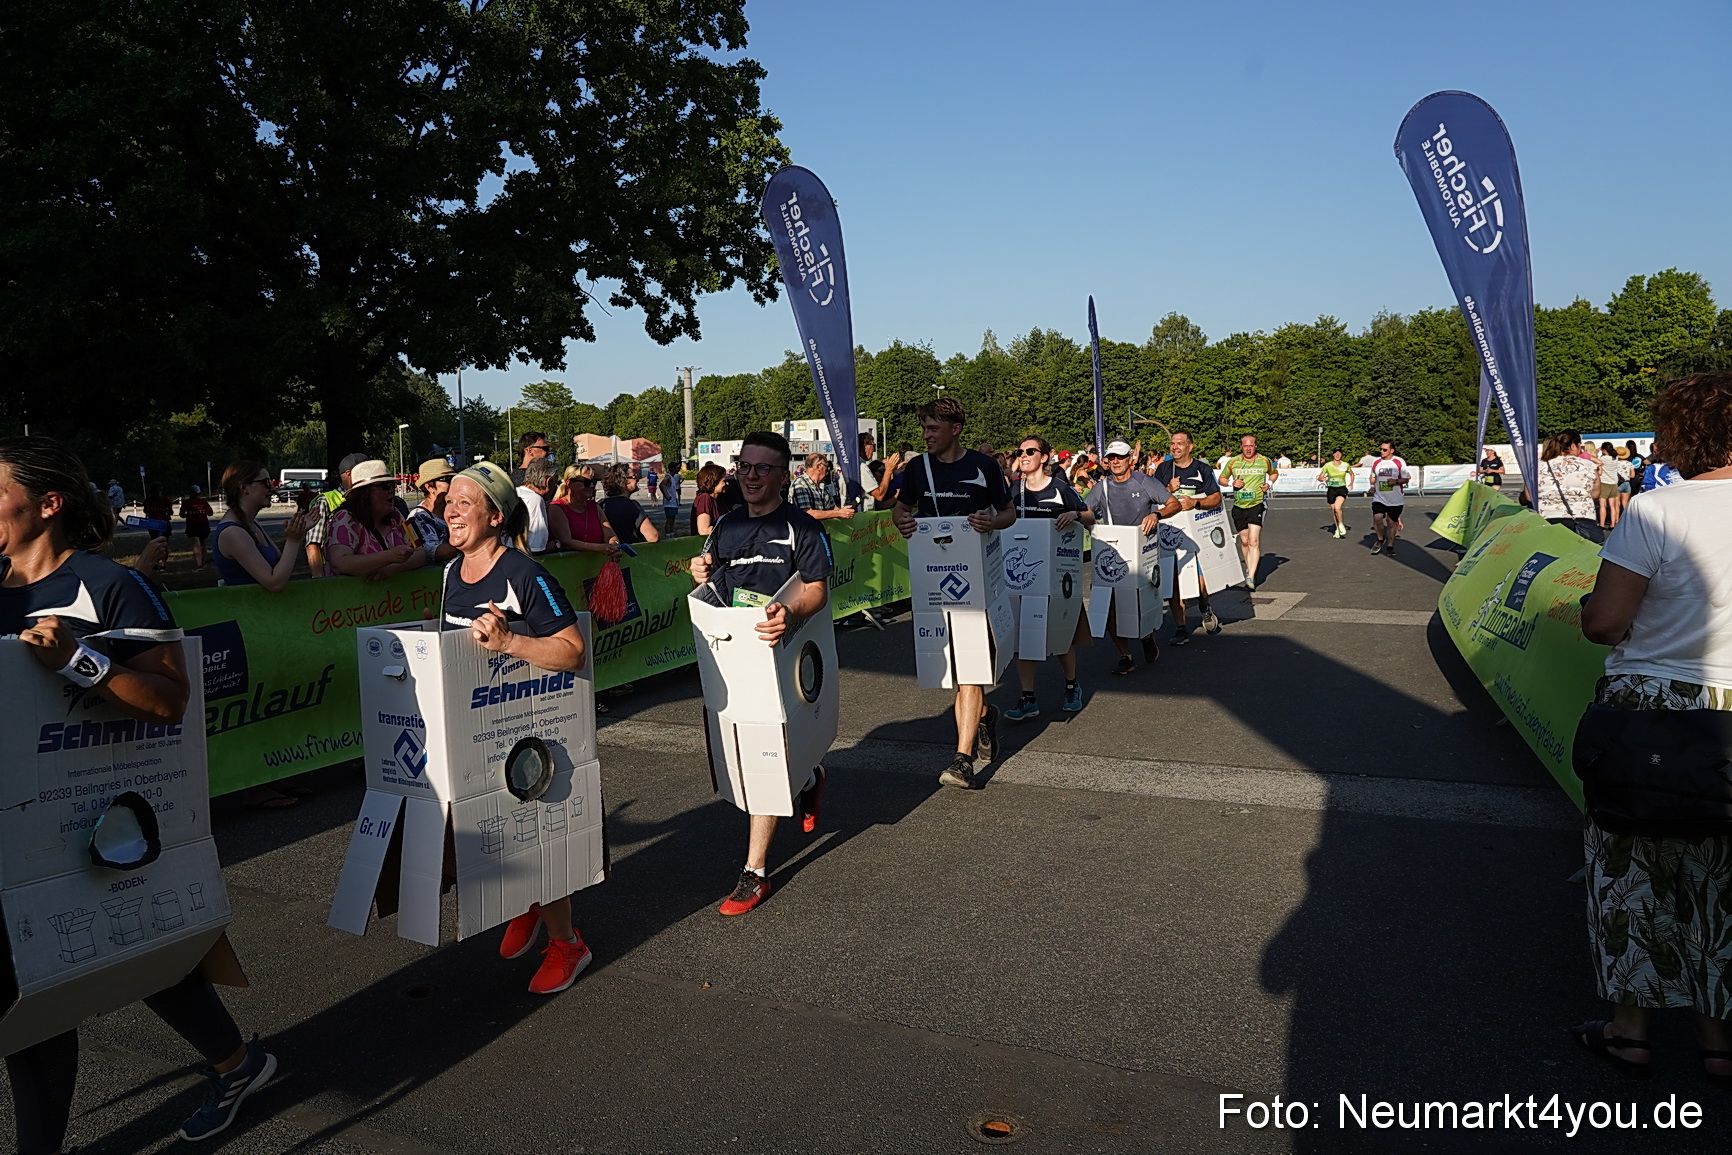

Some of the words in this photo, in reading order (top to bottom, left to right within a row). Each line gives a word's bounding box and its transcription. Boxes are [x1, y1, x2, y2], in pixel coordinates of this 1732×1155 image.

[926, 562, 969, 573] transratio
[919, 627, 932, 638] Gr.
[936, 626, 946, 638] IV
[470, 671, 576, 710] Schmidt
[378, 711, 425, 730] transratio
[472, 730, 496, 744] 92339
[497, 723, 531, 738] Beilngries
[539, 712, 578, 728] Oberbayern
[491, 713, 524, 726] Internationale
[166, 738, 182, 747] Jahren
[495, 741, 507, 750] Tel.
[545, 726, 560, 737] 10-0
[67, 765, 112, 779] Internationale
[112, 757, 162, 772] Möbelspedition
[39, 786, 72, 803] 92339
[75, 779, 121, 797] Beilngries
[123, 777, 132, 788] in
[134, 768, 187, 787] Oberbayern
[71, 802, 89, 814] Tel.
[91, 800, 98, 811] 0
[142, 786, 163, 800] 10-0
[359, 816, 373, 836] Gr.
[377, 819, 392, 839] IV
[108, 876, 148, 896] -BODEN-
